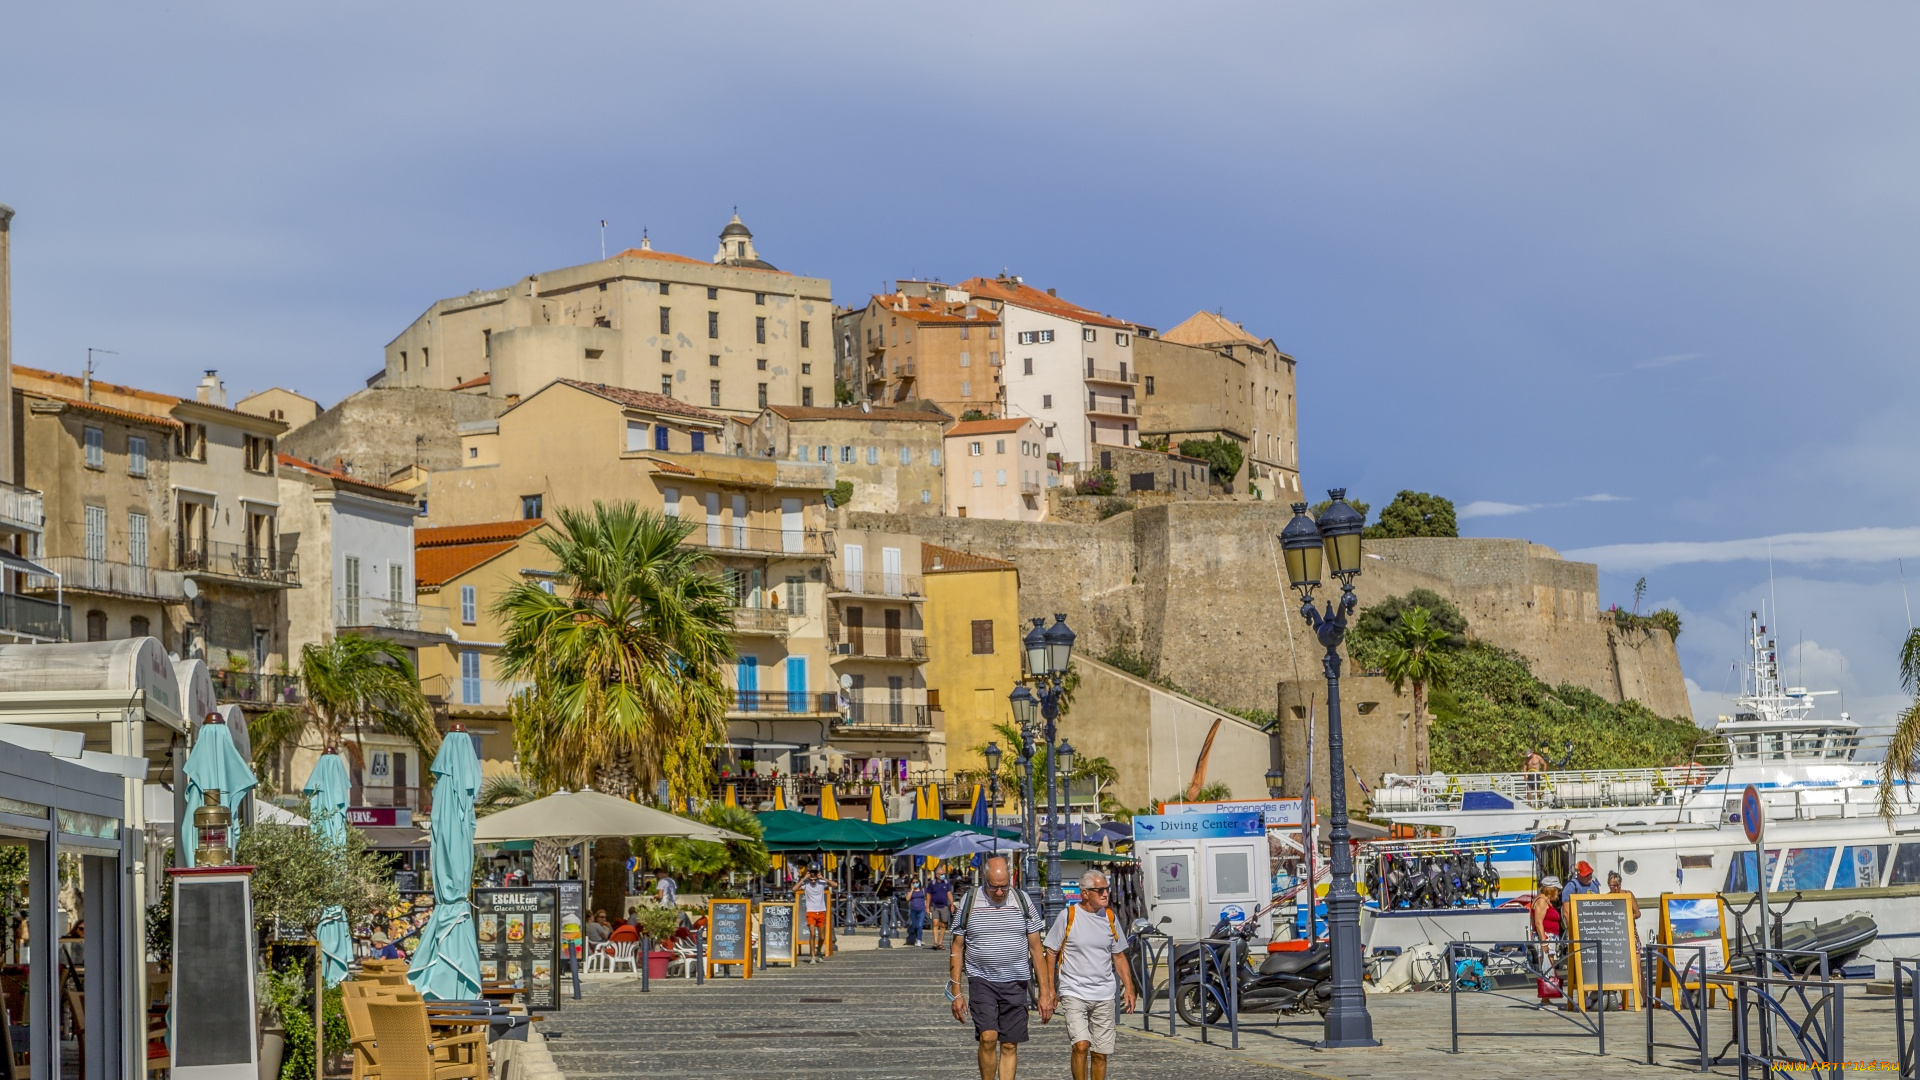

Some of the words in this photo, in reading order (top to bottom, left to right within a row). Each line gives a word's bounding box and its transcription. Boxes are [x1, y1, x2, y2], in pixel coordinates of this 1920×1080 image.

[1216, 803, 1276, 813] Promenades
[1279, 803, 1291, 811] en
[1160, 821, 1199, 832] Diving
[1202, 819, 1238, 829] Center
[492, 893, 525, 904] ESCALE
